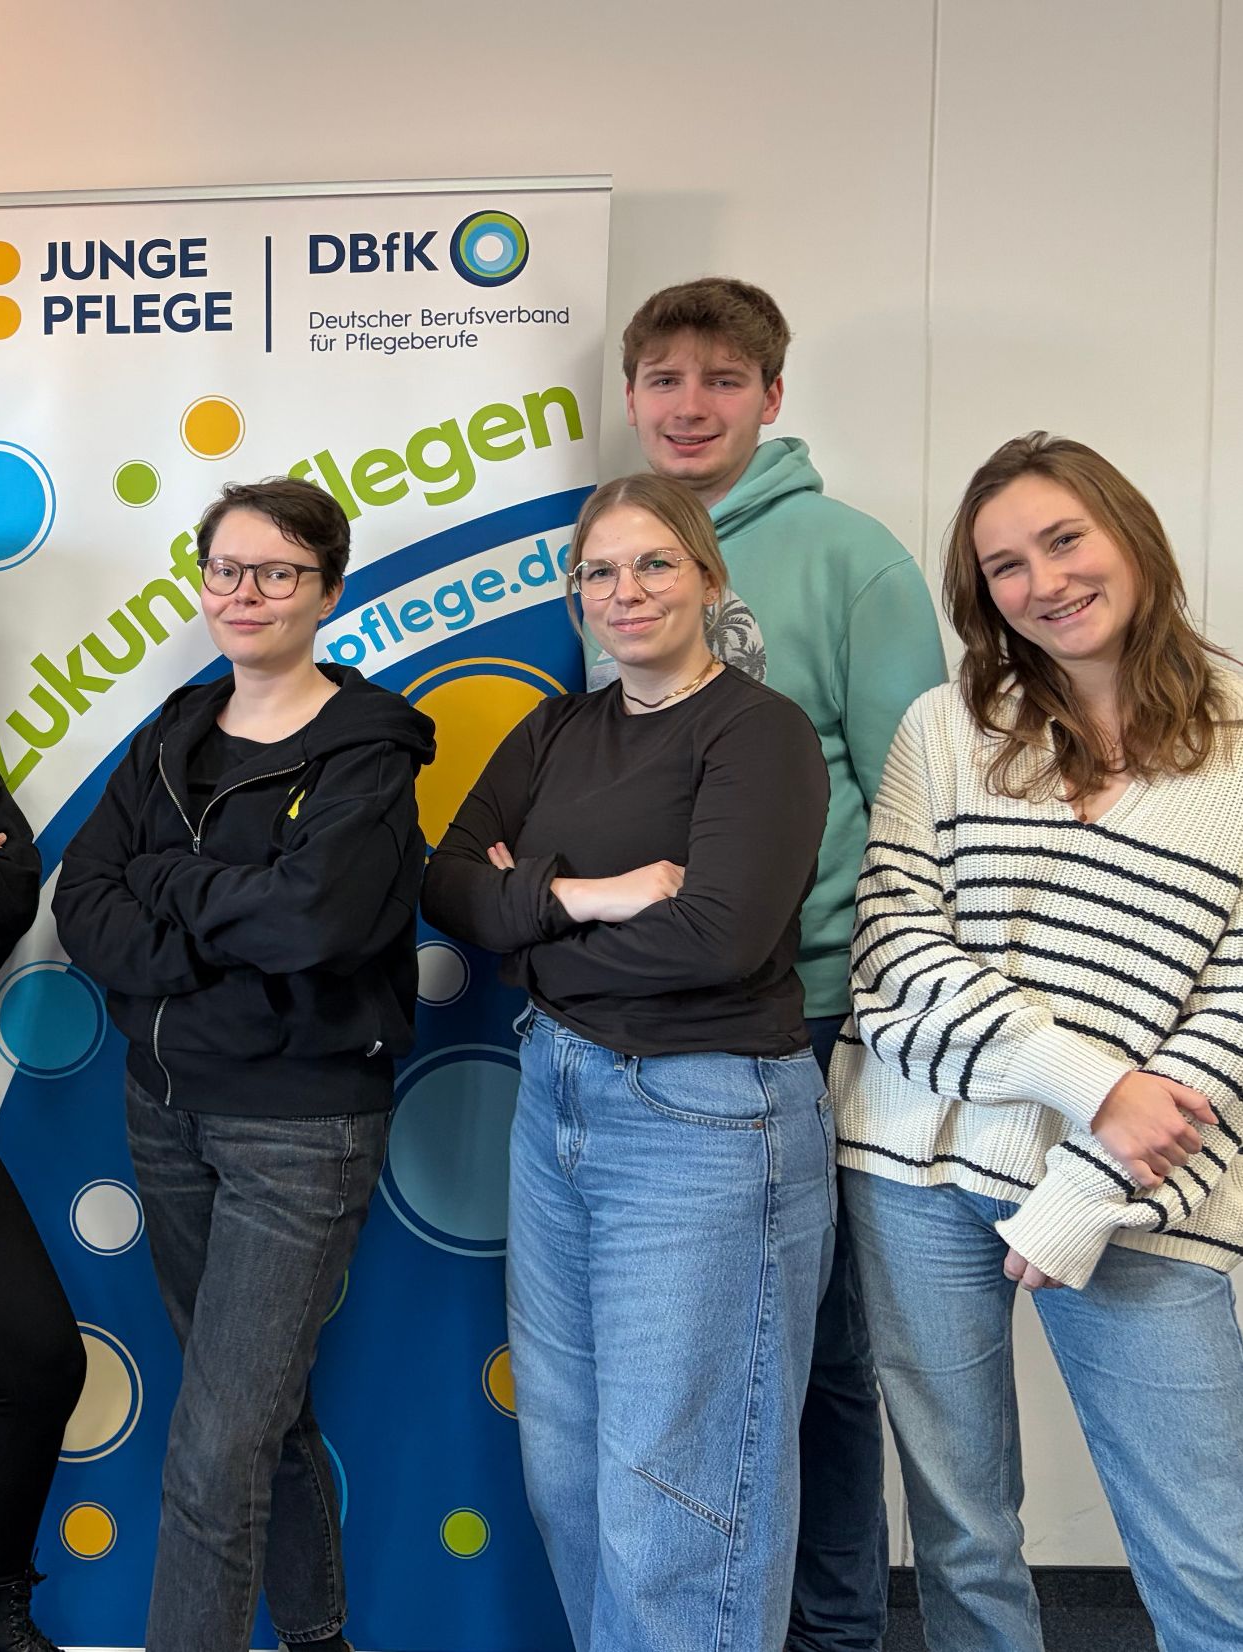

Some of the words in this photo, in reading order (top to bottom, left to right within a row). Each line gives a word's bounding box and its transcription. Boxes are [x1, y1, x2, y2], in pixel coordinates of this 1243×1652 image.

[40, 238, 208, 281] JUNGE
[308, 230, 440, 275] DBfK
[43, 291, 233, 335] PFLEGE
[309, 309, 413, 330] Deutscher
[420, 305, 571, 327] Berufsverband
[309, 334, 337, 352] für
[345, 330, 479, 355] Pflegeberufe
